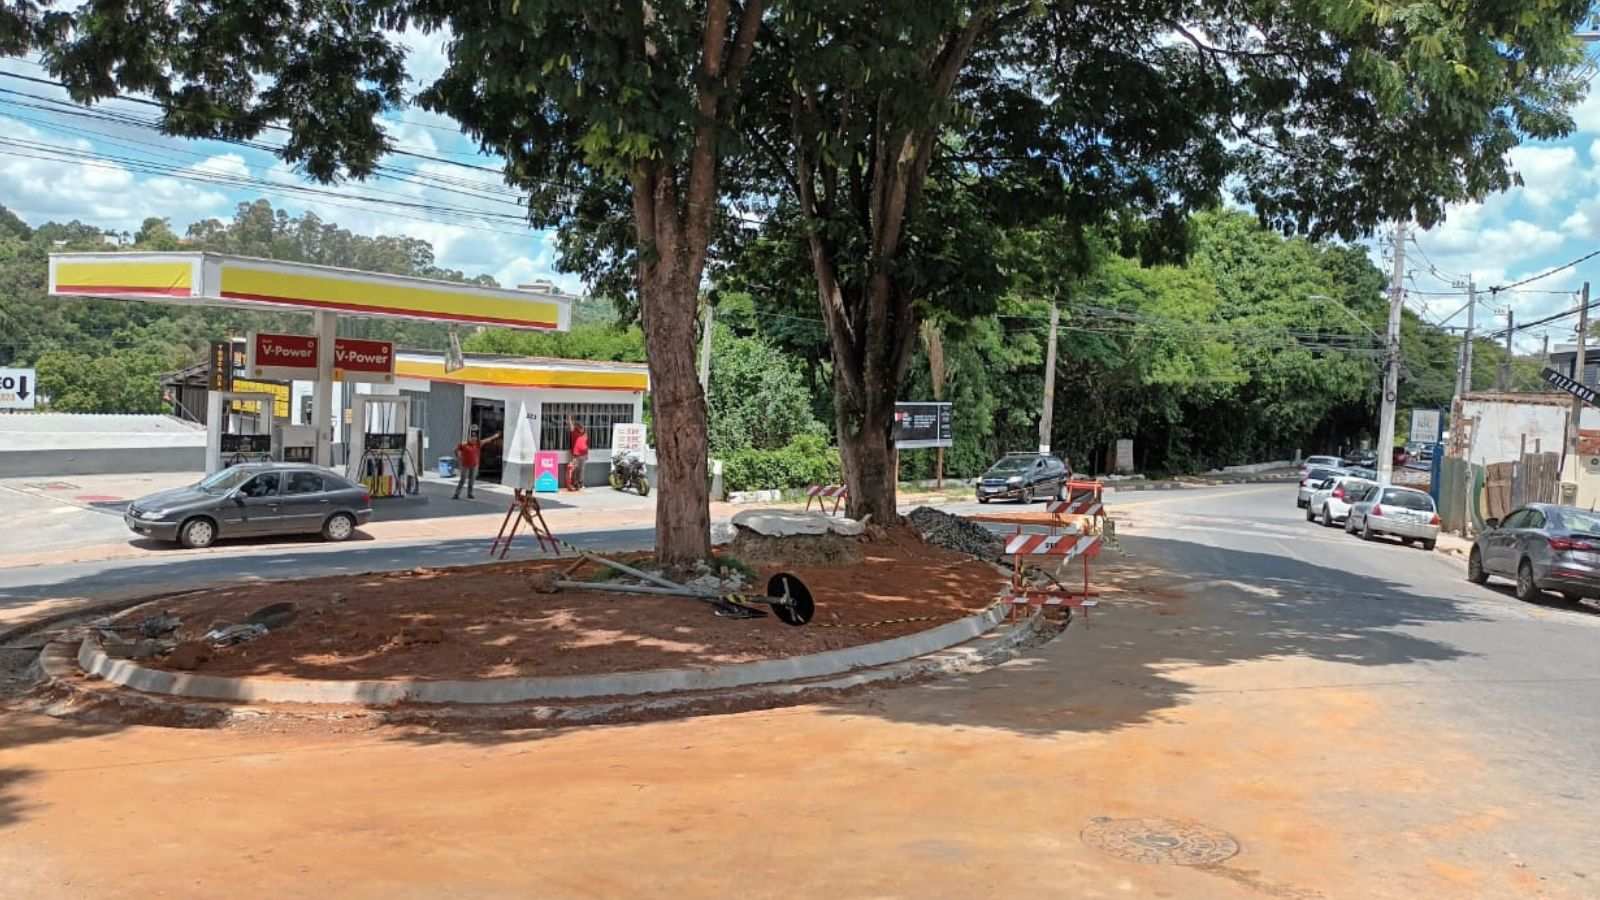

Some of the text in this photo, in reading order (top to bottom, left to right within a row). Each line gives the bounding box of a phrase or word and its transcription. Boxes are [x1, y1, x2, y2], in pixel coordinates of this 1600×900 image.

[262, 344, 312, 358] V-Power
[335, 350, 388, 364] V-Power
[1548, 372, 1595, 401] PIZZARIA
